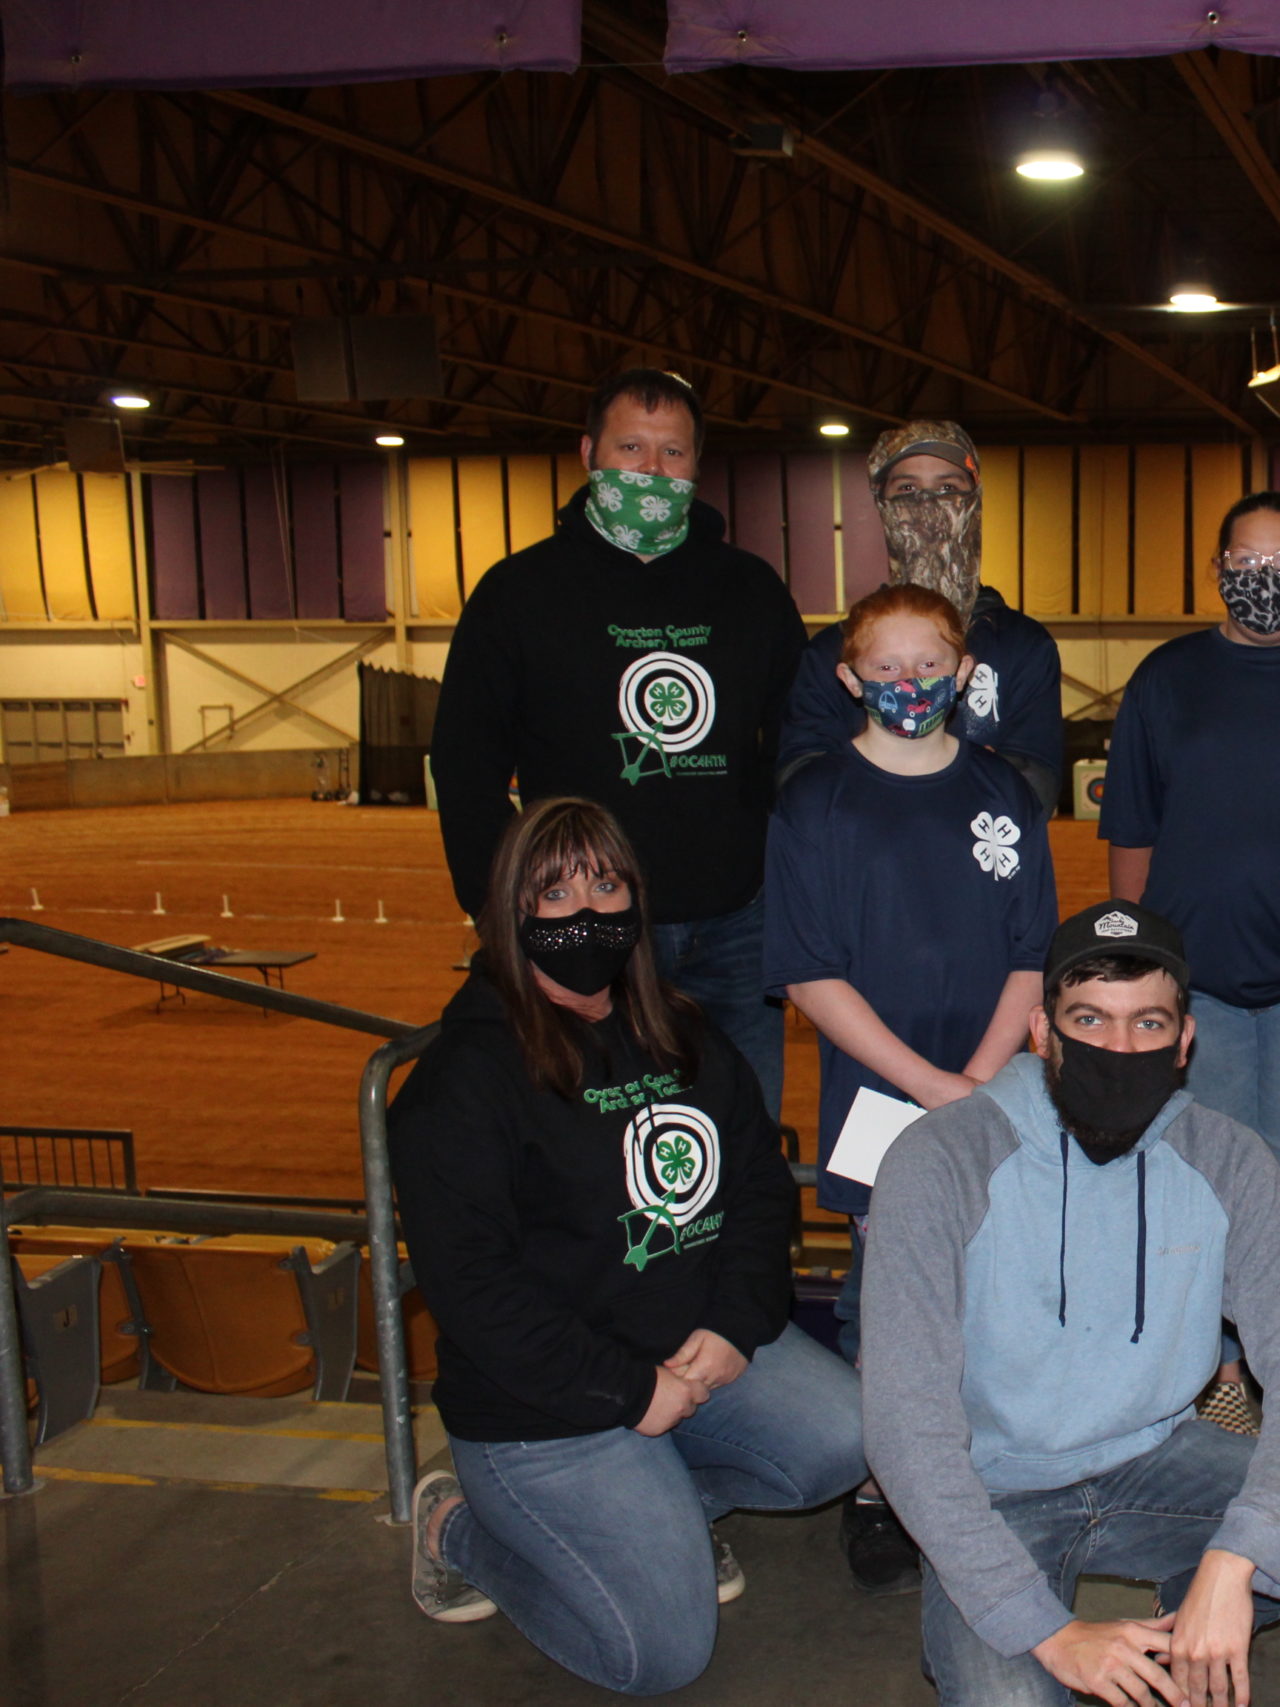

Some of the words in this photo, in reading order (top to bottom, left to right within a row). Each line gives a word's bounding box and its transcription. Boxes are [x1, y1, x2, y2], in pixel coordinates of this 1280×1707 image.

[607, 624, 662, 638] Overton
[665, 624, 712, 638] County
[616, 636, 667, 650] Archery
[671, 635, 708, 648] Team
